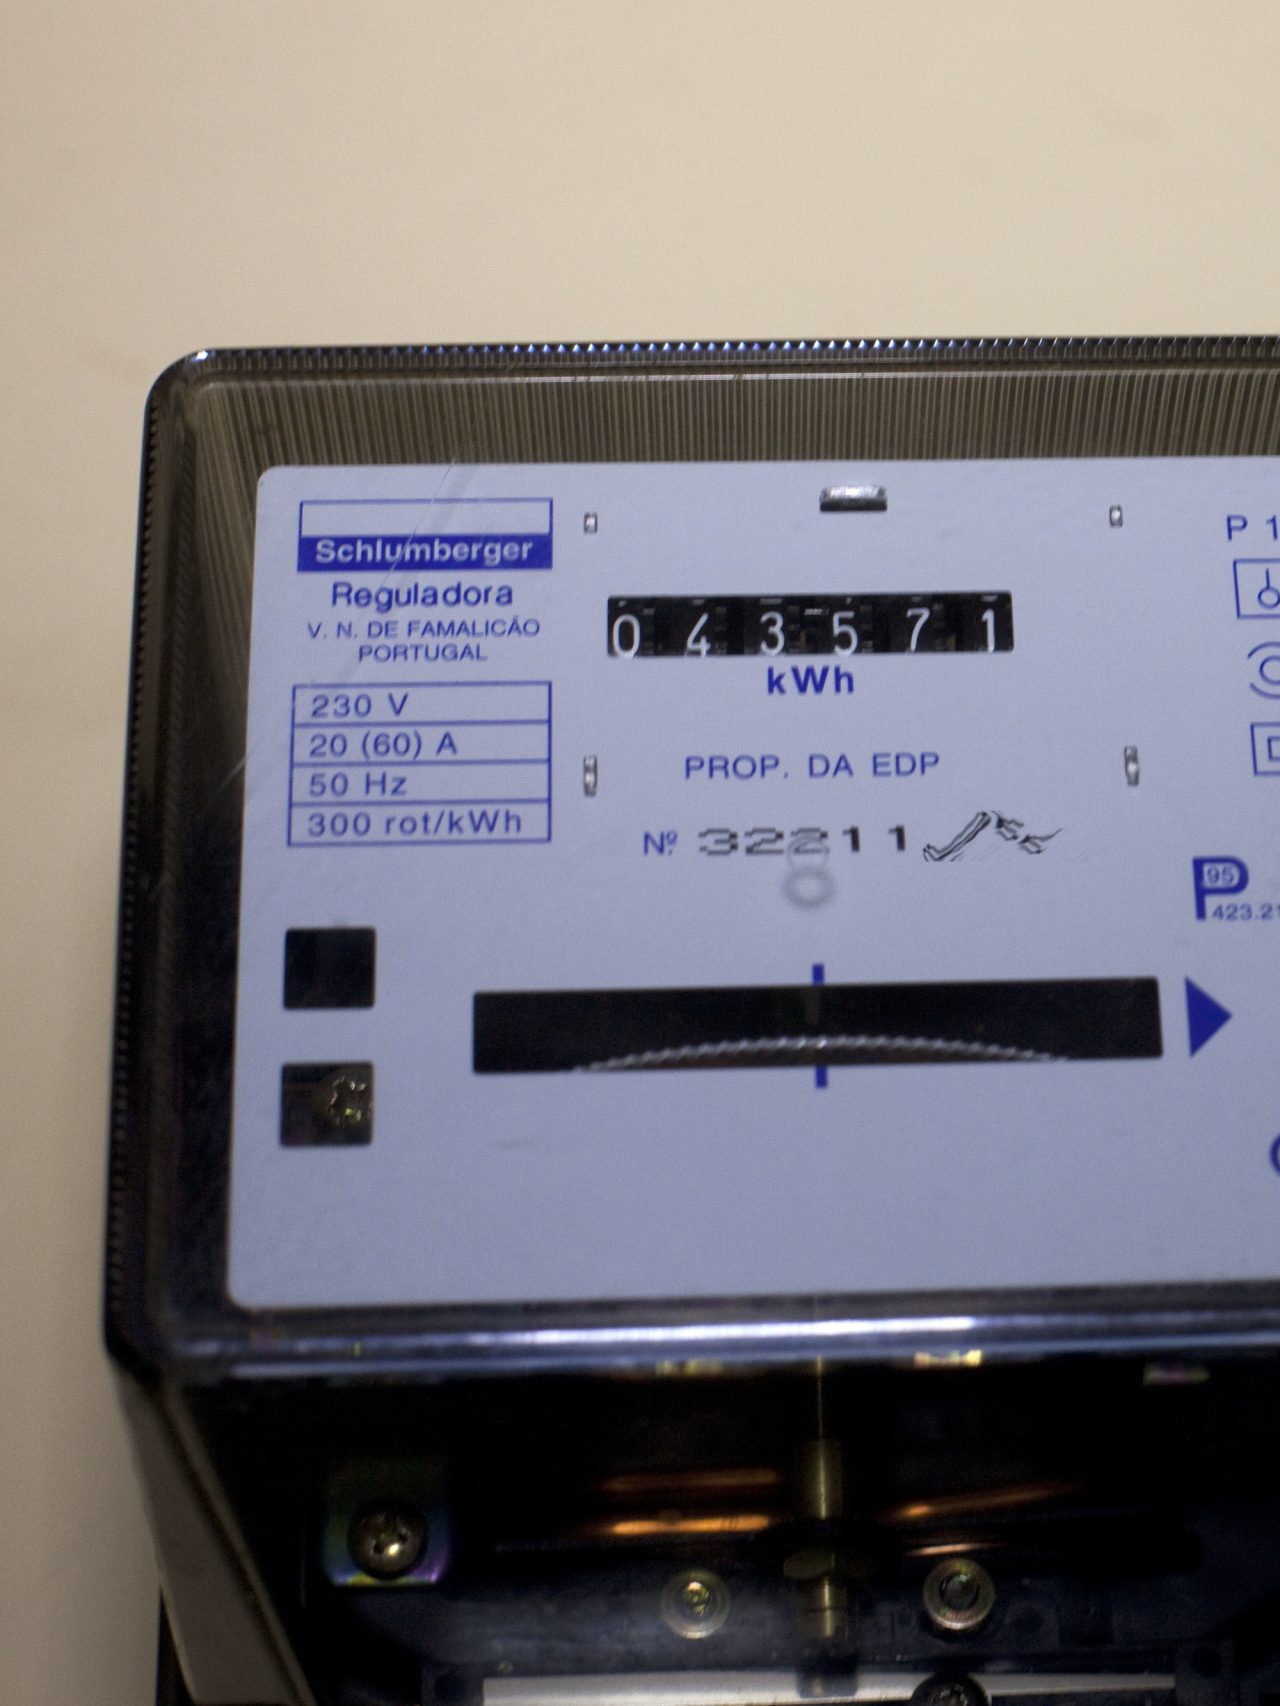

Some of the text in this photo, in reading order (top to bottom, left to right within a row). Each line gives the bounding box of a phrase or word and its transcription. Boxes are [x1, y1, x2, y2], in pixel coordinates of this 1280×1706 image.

[1226, 515, 1248, 541] P
[315, 538, 533, 566] Schlumberger
[331, 581, 514, 613] Reguladora
[308, 622, 328, 640] V.
[336, 621, 359, 639] N.
[368, 620, 399, 637] DE
[359, 643, 488, 663] PORTUGAL
[767, 664, 856, 695] kWh
[311, 693, 409, 718] 230 V
[308, 731, 458, 763] 20 (60) A
[684, 752, 940, 779] PROP. DA EDP
[309, 771, 407, 797] 50 Hz
[308, 808, 522, 837] 300 rot/kWh
[1192, 855, 1249, 921] P
[1206, 865, 1234, 886] 95
